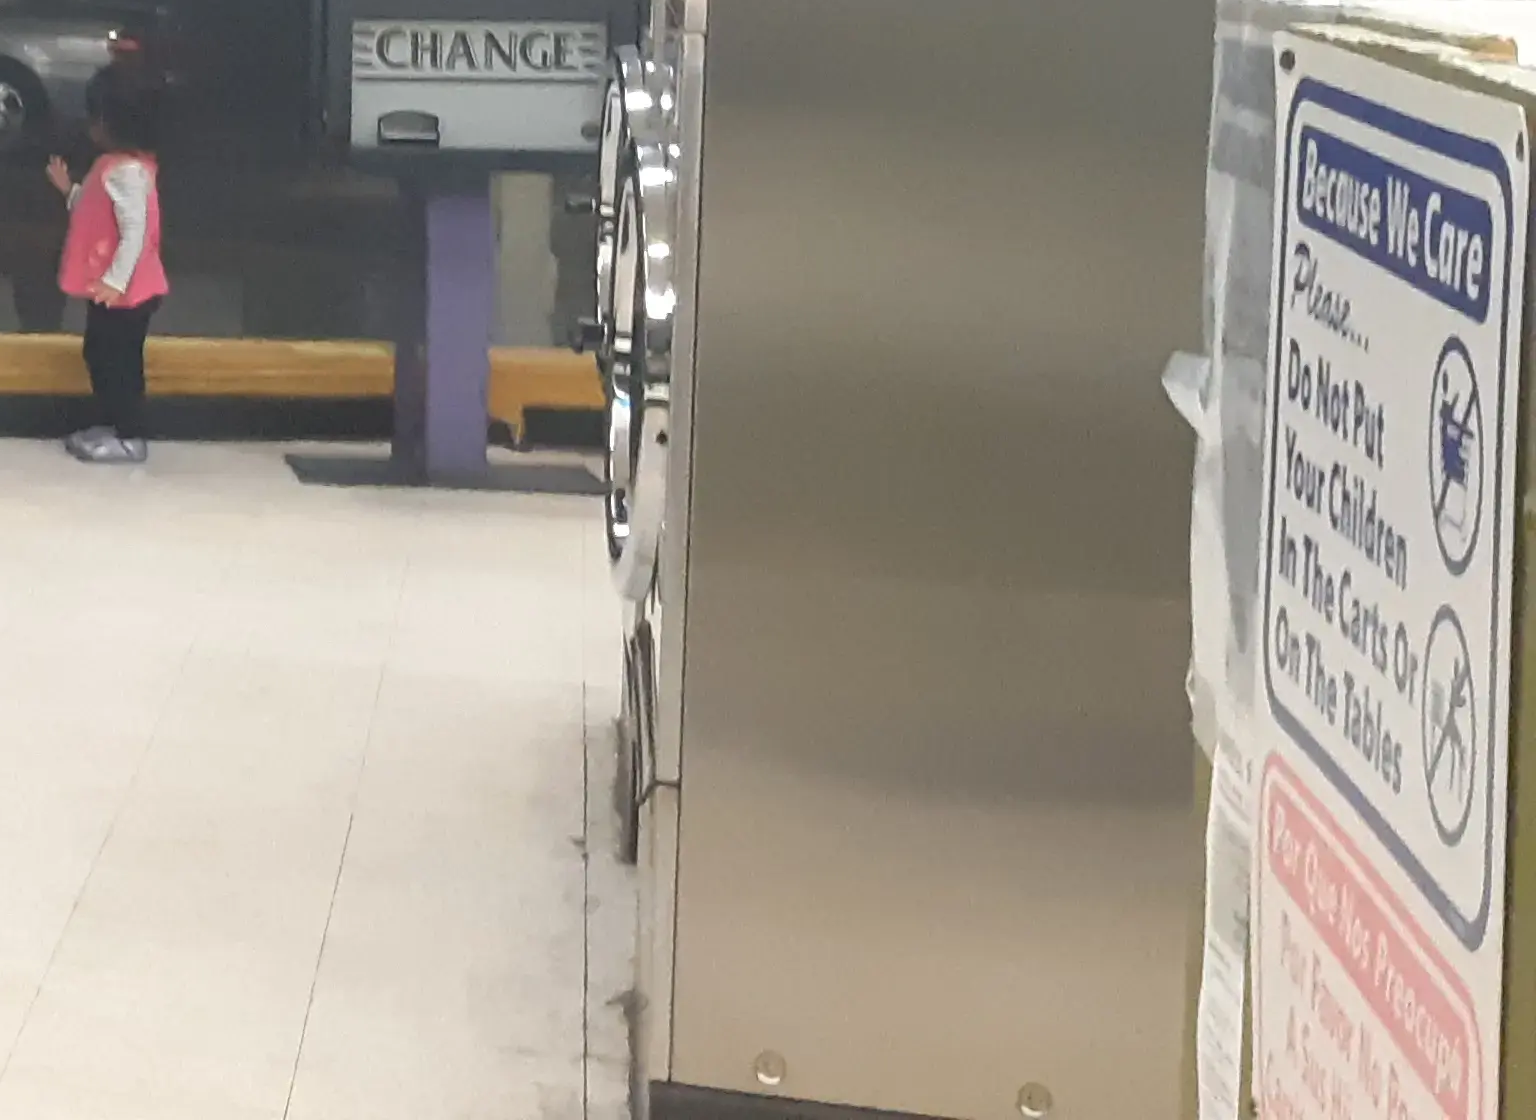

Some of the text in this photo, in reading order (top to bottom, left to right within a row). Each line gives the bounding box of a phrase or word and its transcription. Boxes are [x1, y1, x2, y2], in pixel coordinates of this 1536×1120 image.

[374, 24, 580, 73] CHANGE
[1302, 139, 1486, 302] Because We Care
[1288, 338, 1385, 469] Do Not Put
[1284, 425, 1407, 591] Your Children
[1279, 515, 1420, 706] In The Carts Or
[1275, 605, 1403, 794] On The Tables
[1272, 803, 1301, 877] Por
[1303, 843, 1339, 928] Que
[1340, 883, 1371, 971] Nos
